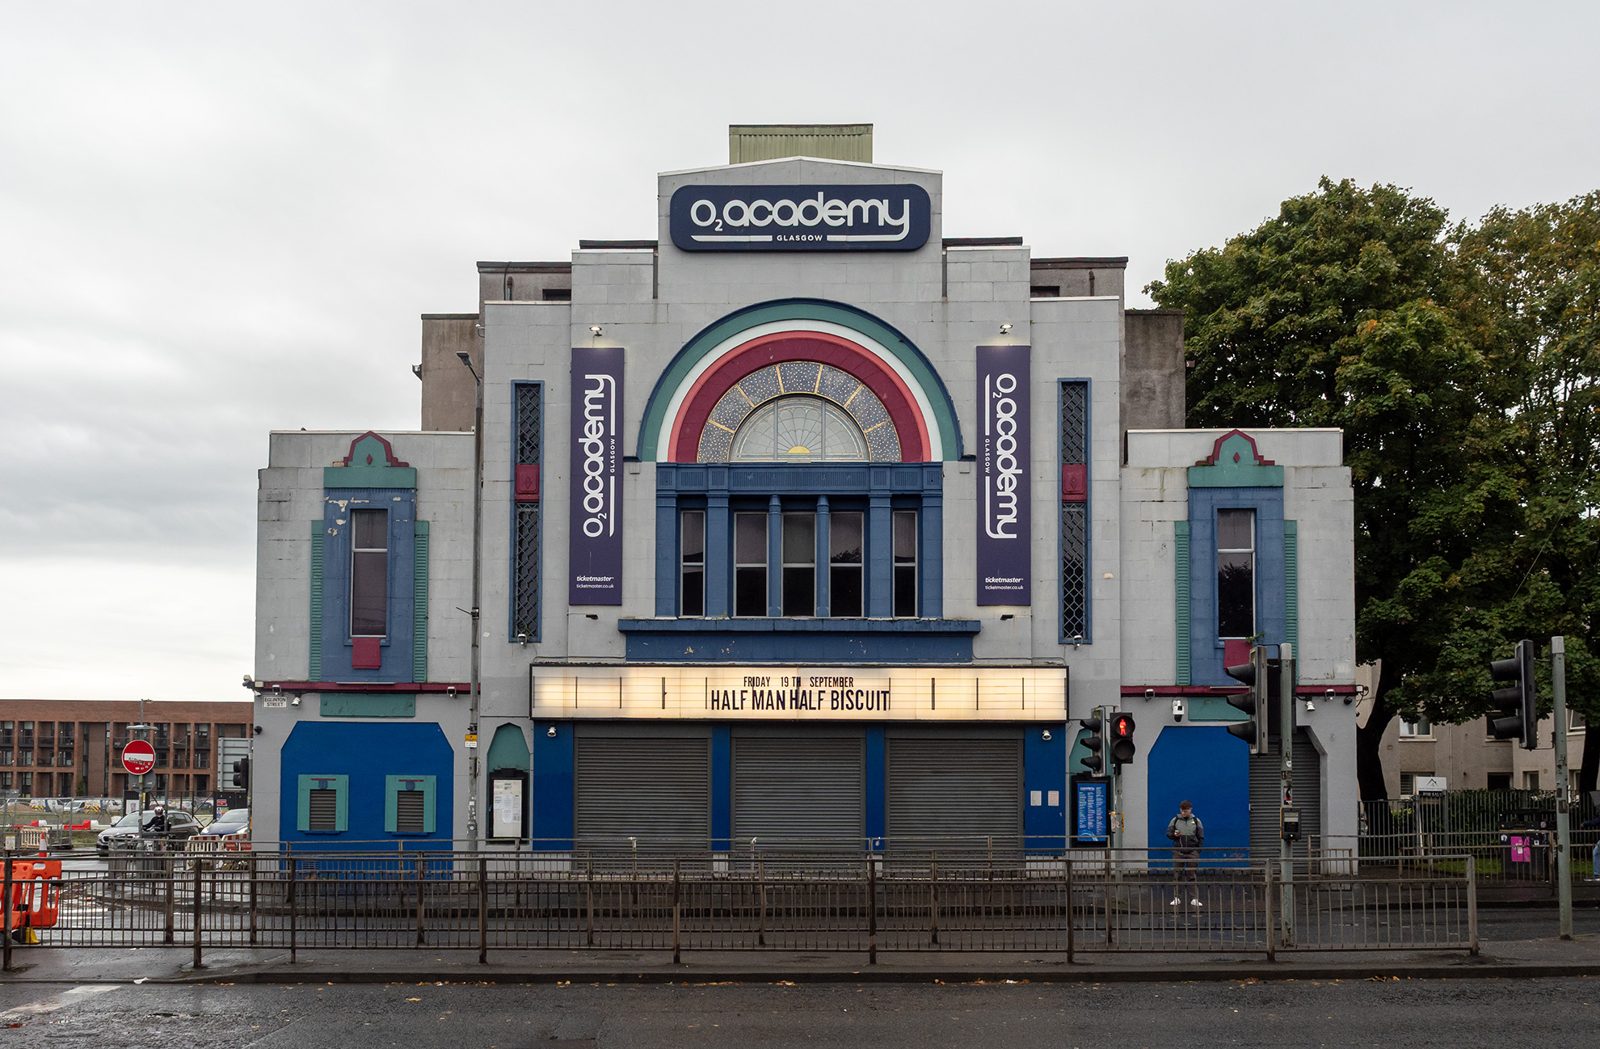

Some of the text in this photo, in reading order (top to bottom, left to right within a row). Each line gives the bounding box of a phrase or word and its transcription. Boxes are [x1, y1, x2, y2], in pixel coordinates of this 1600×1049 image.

[743, 676, 770, 688] FRIDAY
[809, 676, 854, 688] SEPTEMBER
[711, 689, 890, 711] HALF MAN HALF BISCUIT
